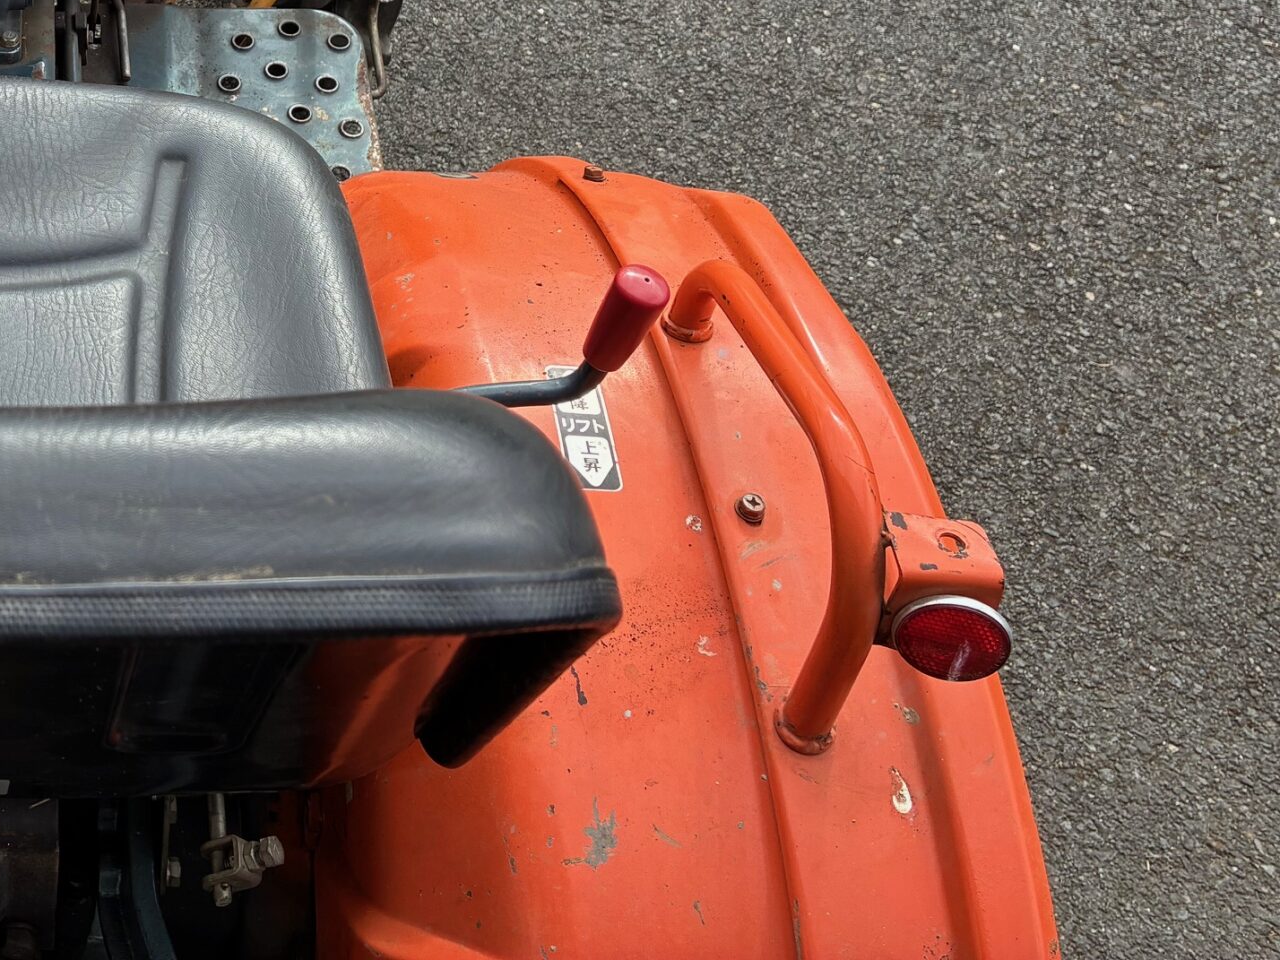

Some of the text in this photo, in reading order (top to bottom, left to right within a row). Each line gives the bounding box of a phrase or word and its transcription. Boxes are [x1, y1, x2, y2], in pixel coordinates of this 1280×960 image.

[561, 417, 605, 434] リフト
[581, 440, 601, 473] 上昇
